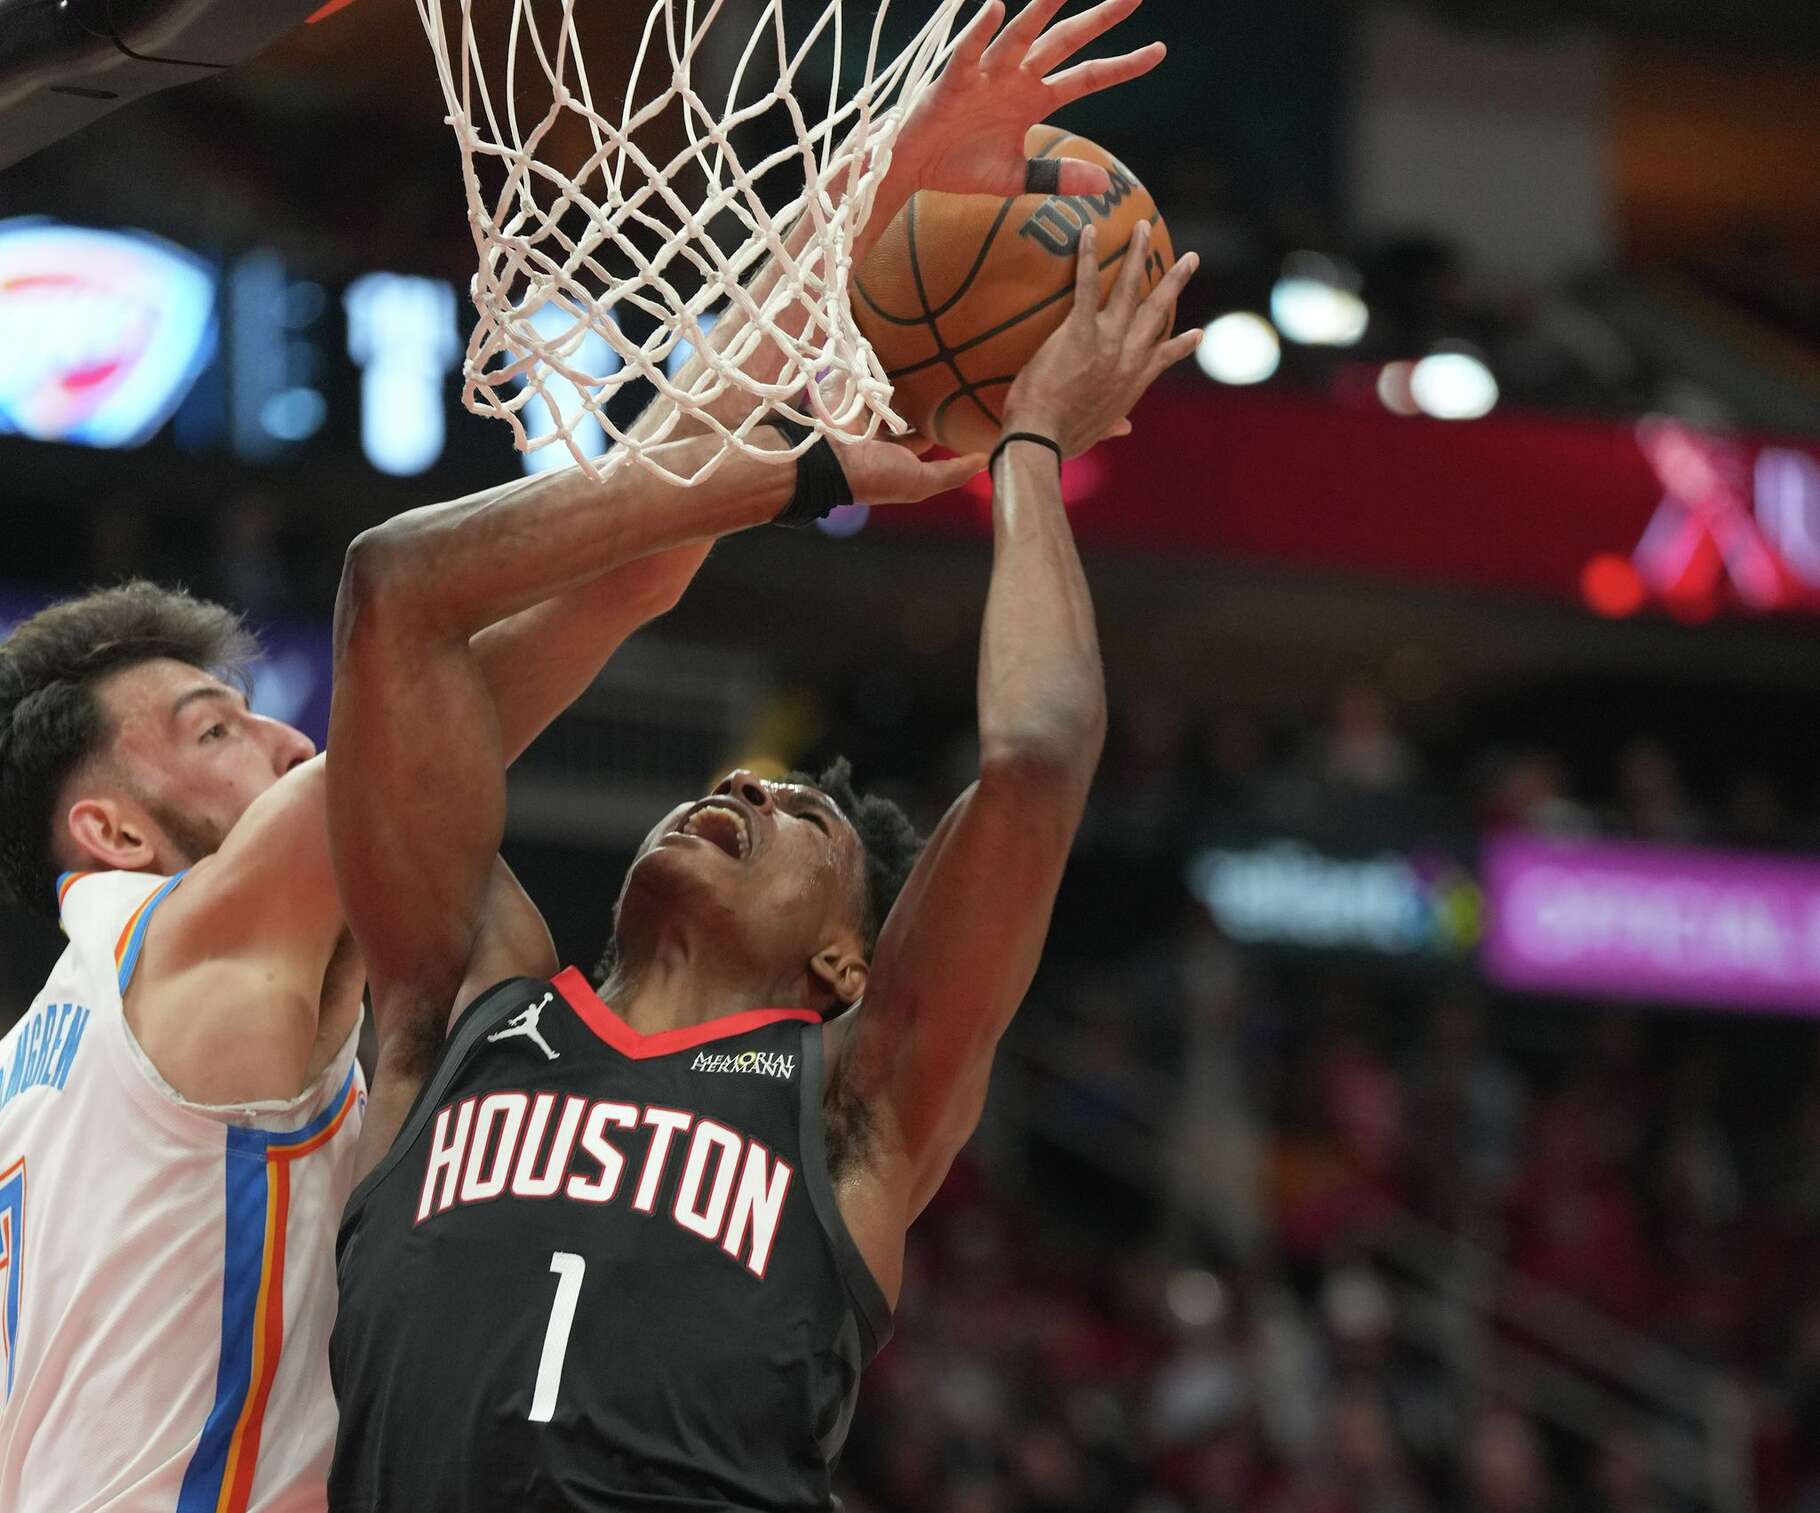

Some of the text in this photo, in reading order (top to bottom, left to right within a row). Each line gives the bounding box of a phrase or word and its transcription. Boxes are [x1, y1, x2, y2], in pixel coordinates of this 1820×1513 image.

[690, 1060, 795, 1079] HERMANN
[693, 1051, 795, 1068] MEMORIAL
[414, 1091, 794, 1280] HOUSTON
[527, 1251, 586, 1422] 1
